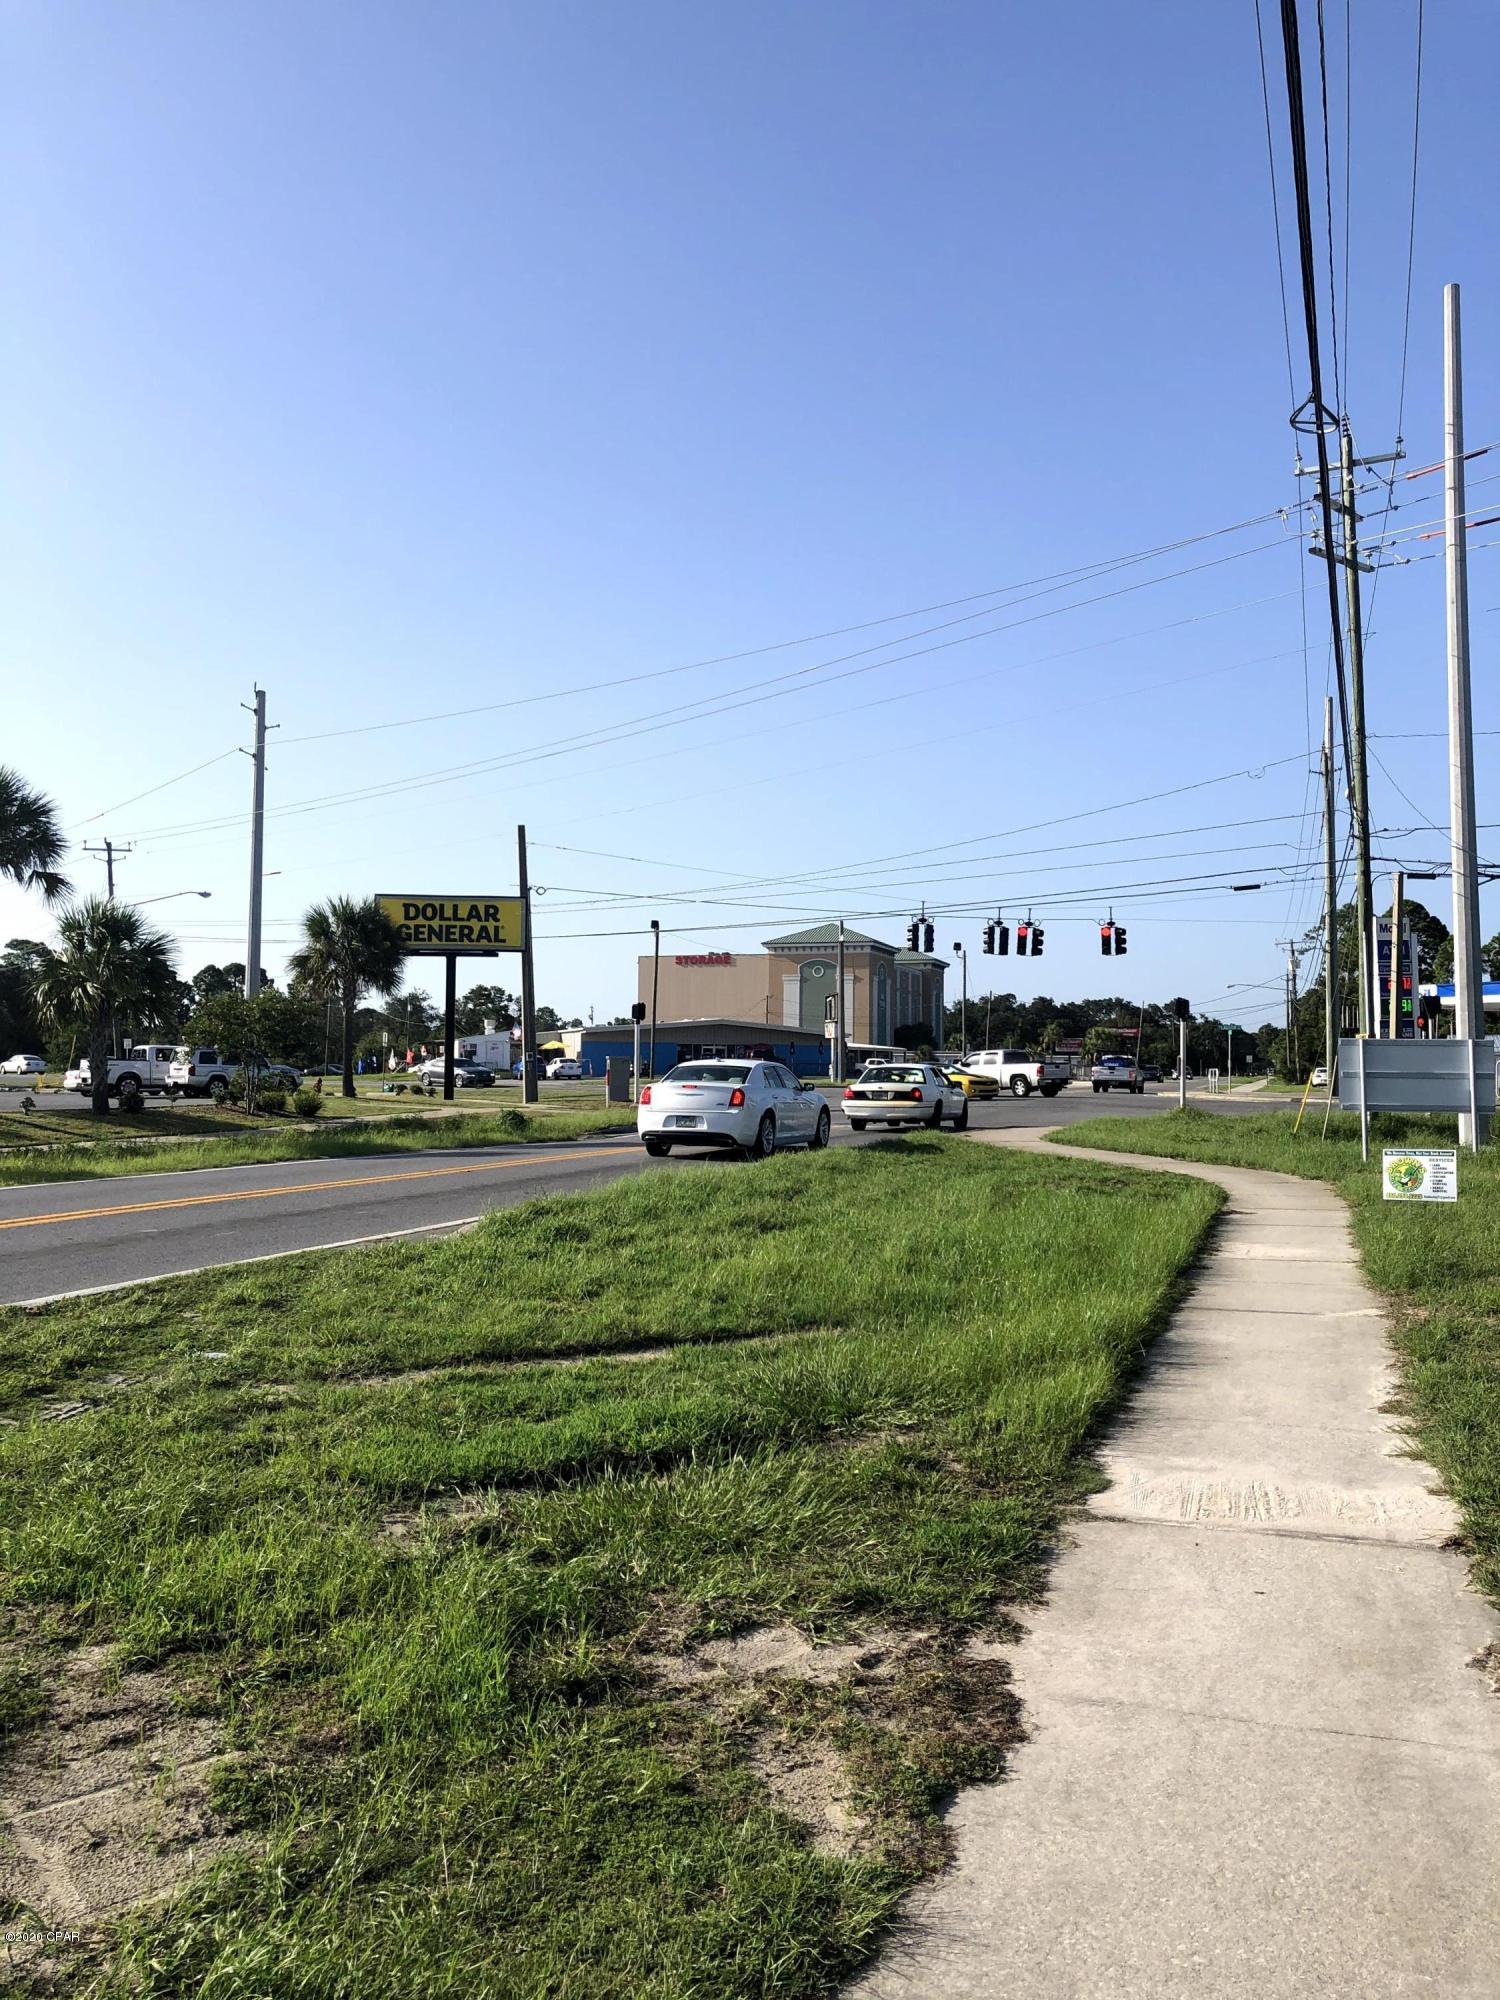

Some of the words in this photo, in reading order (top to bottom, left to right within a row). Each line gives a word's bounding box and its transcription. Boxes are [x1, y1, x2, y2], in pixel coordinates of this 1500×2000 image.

[402, 902, 501, 923] DOLLAR
[397, 923, 507, 943] GENERAL
[674, 954, 733, 966] STORAGE
